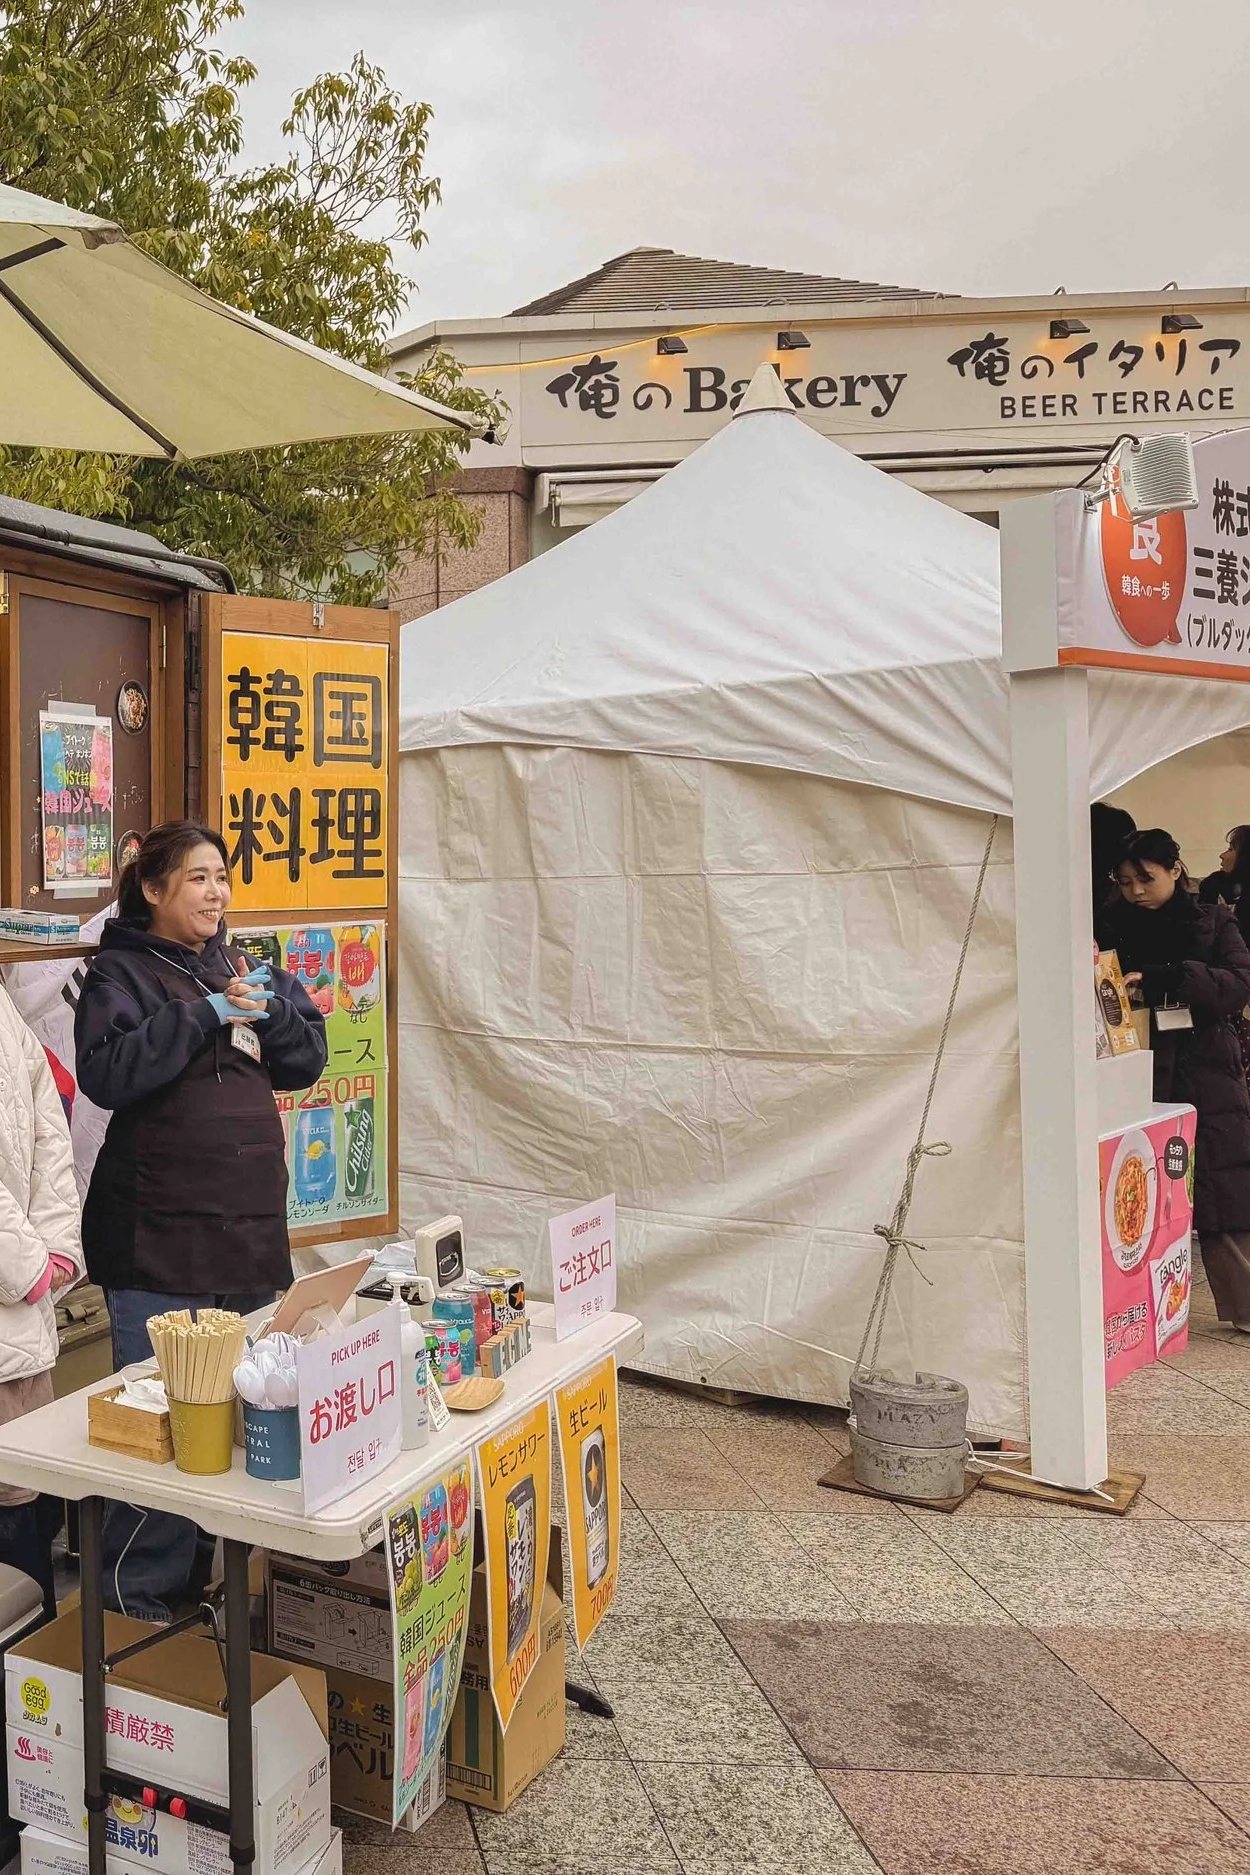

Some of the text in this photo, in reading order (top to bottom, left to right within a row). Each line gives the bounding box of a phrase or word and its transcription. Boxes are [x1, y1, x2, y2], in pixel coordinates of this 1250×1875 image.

[947, 332, 1241, 386] 俺のイタリア
[546, 354, 672, 419] 俺の
[1000, 387, 1234, 418] BEER TERRACE
[1121, 575, 1170, 601] 韓食への一歩
[227, 666, 383, 769] 韓国
[230, 786, 386, 885] 料理
[345, 1108, 374, 1192] Chilsung
[571, 1215, 601, 1237] ORDER HERE
[559, 1239, 612, 1293] ご注文口
[331, 1329, 380, 1366] PICK UP HERE
[309, 1359, 395, 1445] お渡し口
[569, 1387, 608, 1438] 生ビール
[251, 1453, 272, 1465] PARK
[488, 1434, 546, 1489] レモンサワー
[400, 1573, 466, 1660] 韓国ジュース
[24, 1682, 47, 1700] Good
[509, 1633, 537, 1699] 600円
[330, 1742, 394, 1781] ベル
